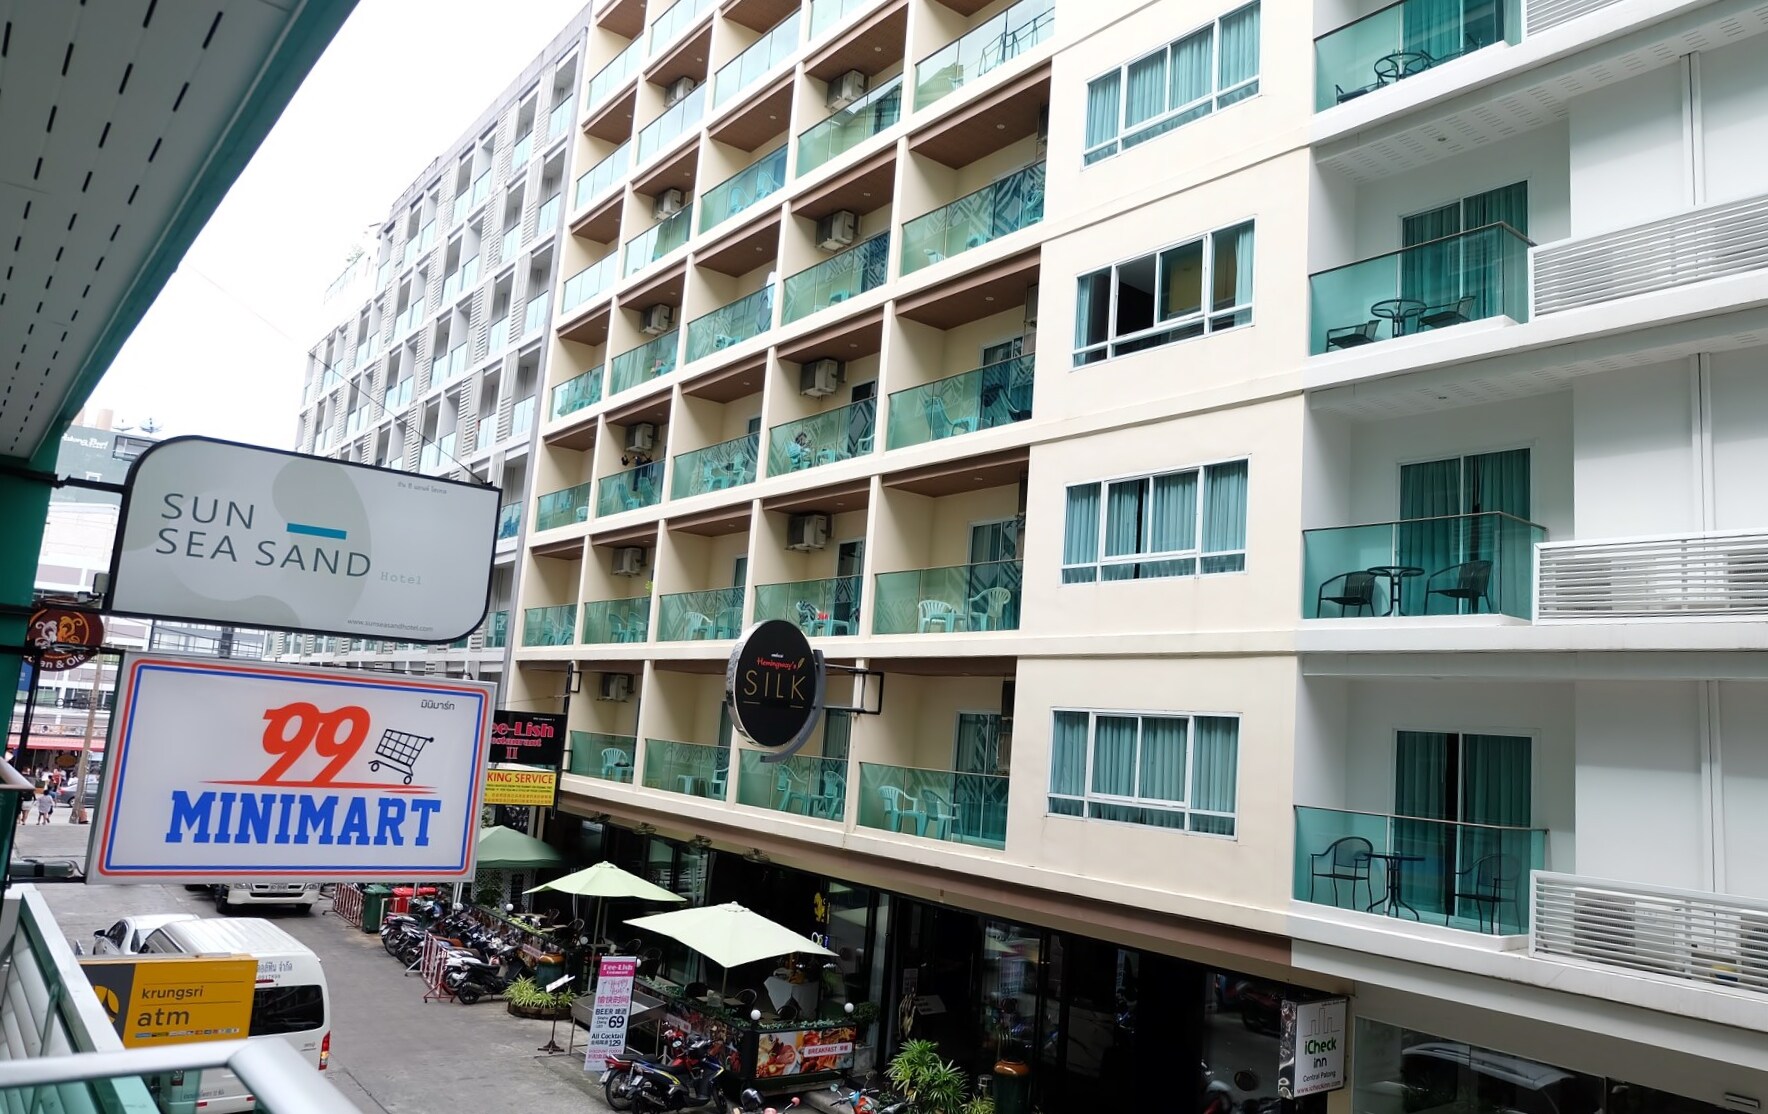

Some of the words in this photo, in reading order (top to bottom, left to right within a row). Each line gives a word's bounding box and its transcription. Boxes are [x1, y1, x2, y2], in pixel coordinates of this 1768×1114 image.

[161, 493, 254, 530] SUN
[155, 528, 237, 562] SEA
[255, 540, 371, 577] SAND
[380, 571, 422, 585] Hotel
[347, 618, 434, 632] www.sunseasandhotel.com
[757, 656, 797, 671] Hemingway's
[743, 669, 806, 701] SILK
[492, 722, 554, 738] ee-Lish
[257, 702, 371, 783] 99
[505, 746, 518, 759] II
[487, 772, 512, 783] KING
[515, 773, 554, 784] SERVICE
[165, 790, 442, 847] MINIMART
[141, 986, 204, 1000] krungsri
[137, 1008, 190, 1027] atm
[608, 1015, 625, 1028] 69
[600, 1032, 624, 1040] Cocktail
[608, 1039, 622, 1047] 129
[807, 1046, 837, 1055] BREAKFAST
[1304, 1036, 1337, 1056] iCheck
[1313, 1057, 1327, 1069] inn
[1303, 1073, 1321, 1082] Central
[1320, 1070, 1336, 1079] Patong
